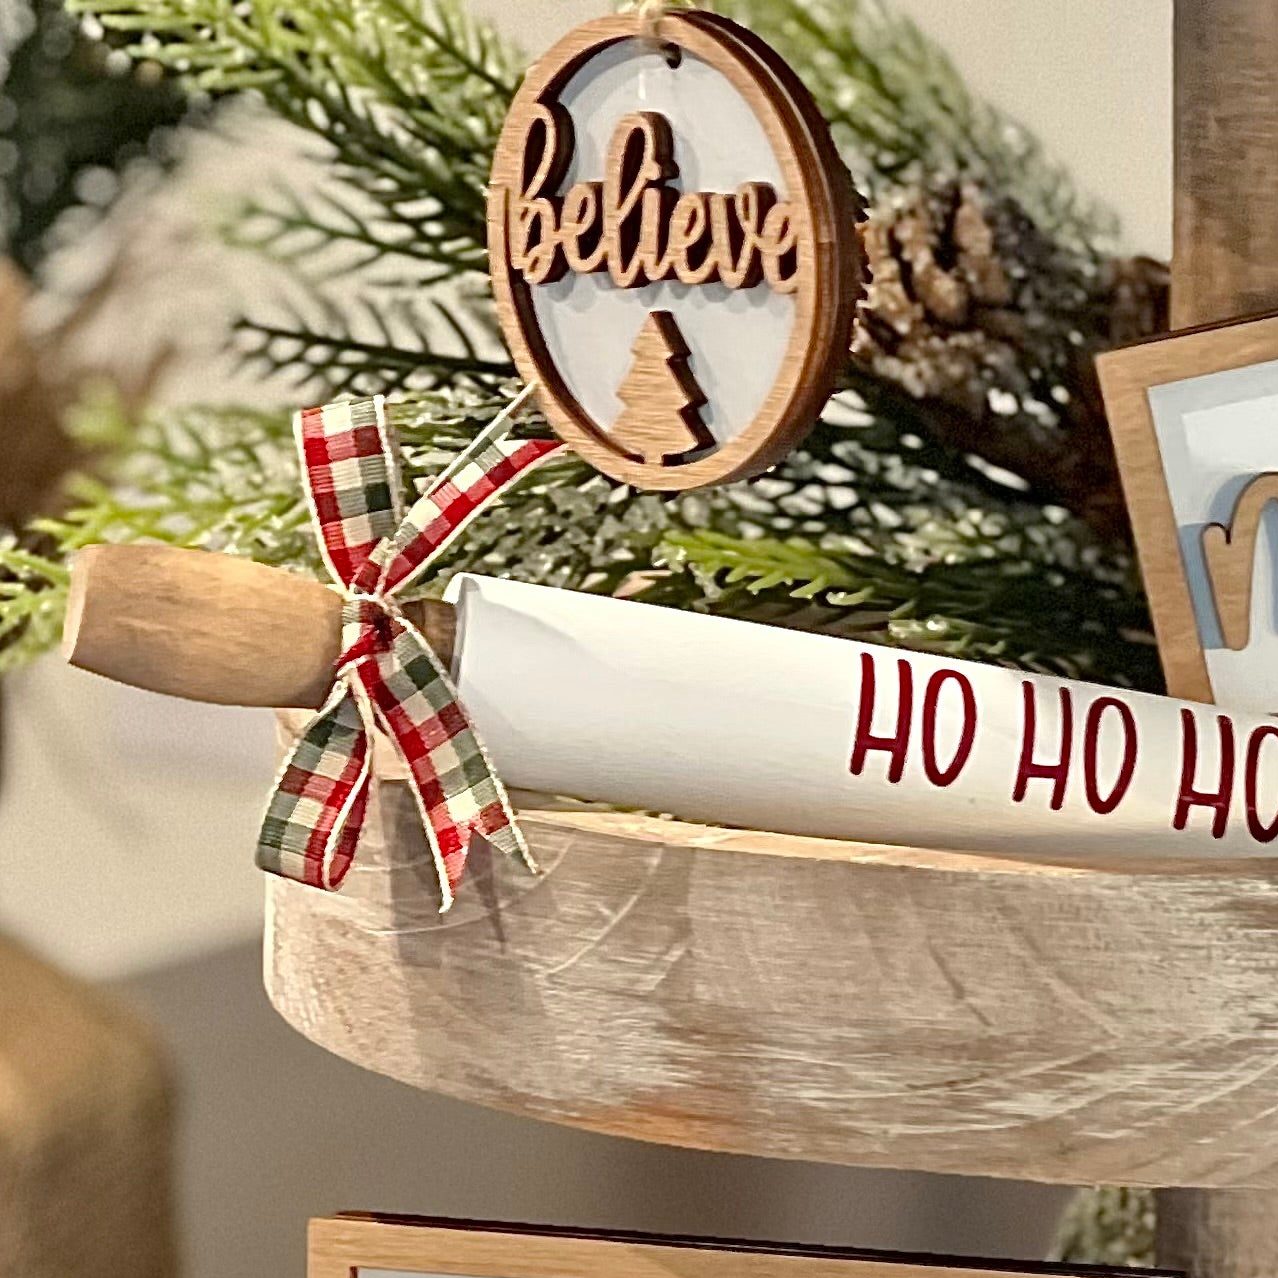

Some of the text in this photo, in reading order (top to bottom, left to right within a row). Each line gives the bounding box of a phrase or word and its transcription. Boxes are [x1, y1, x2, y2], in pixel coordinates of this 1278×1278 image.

[506, 98, 801, 294] believe
[849, 651, 978, 788] HO
[1012, 679, 1138, 815] HO
